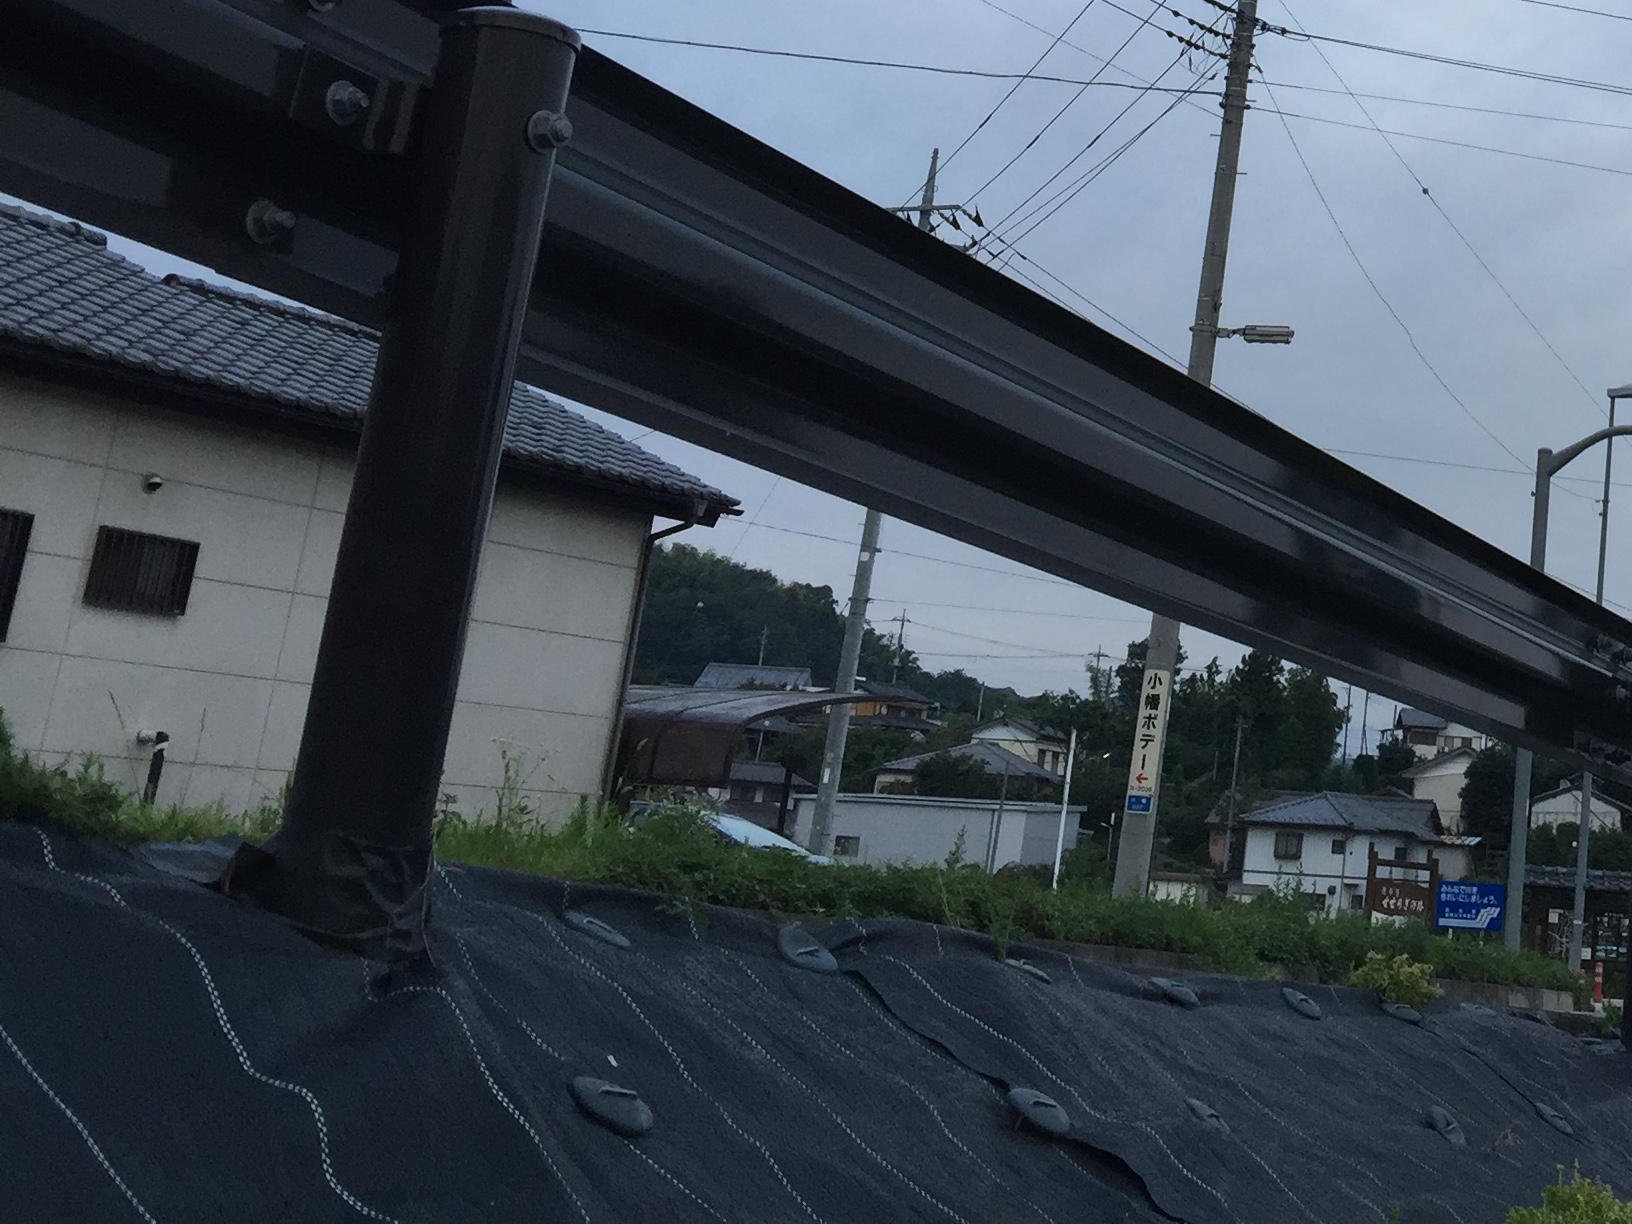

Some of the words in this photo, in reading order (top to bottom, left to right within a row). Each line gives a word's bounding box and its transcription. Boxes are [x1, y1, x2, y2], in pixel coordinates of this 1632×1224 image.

[1139, 672, 1163, 771] 小幡ボデー
